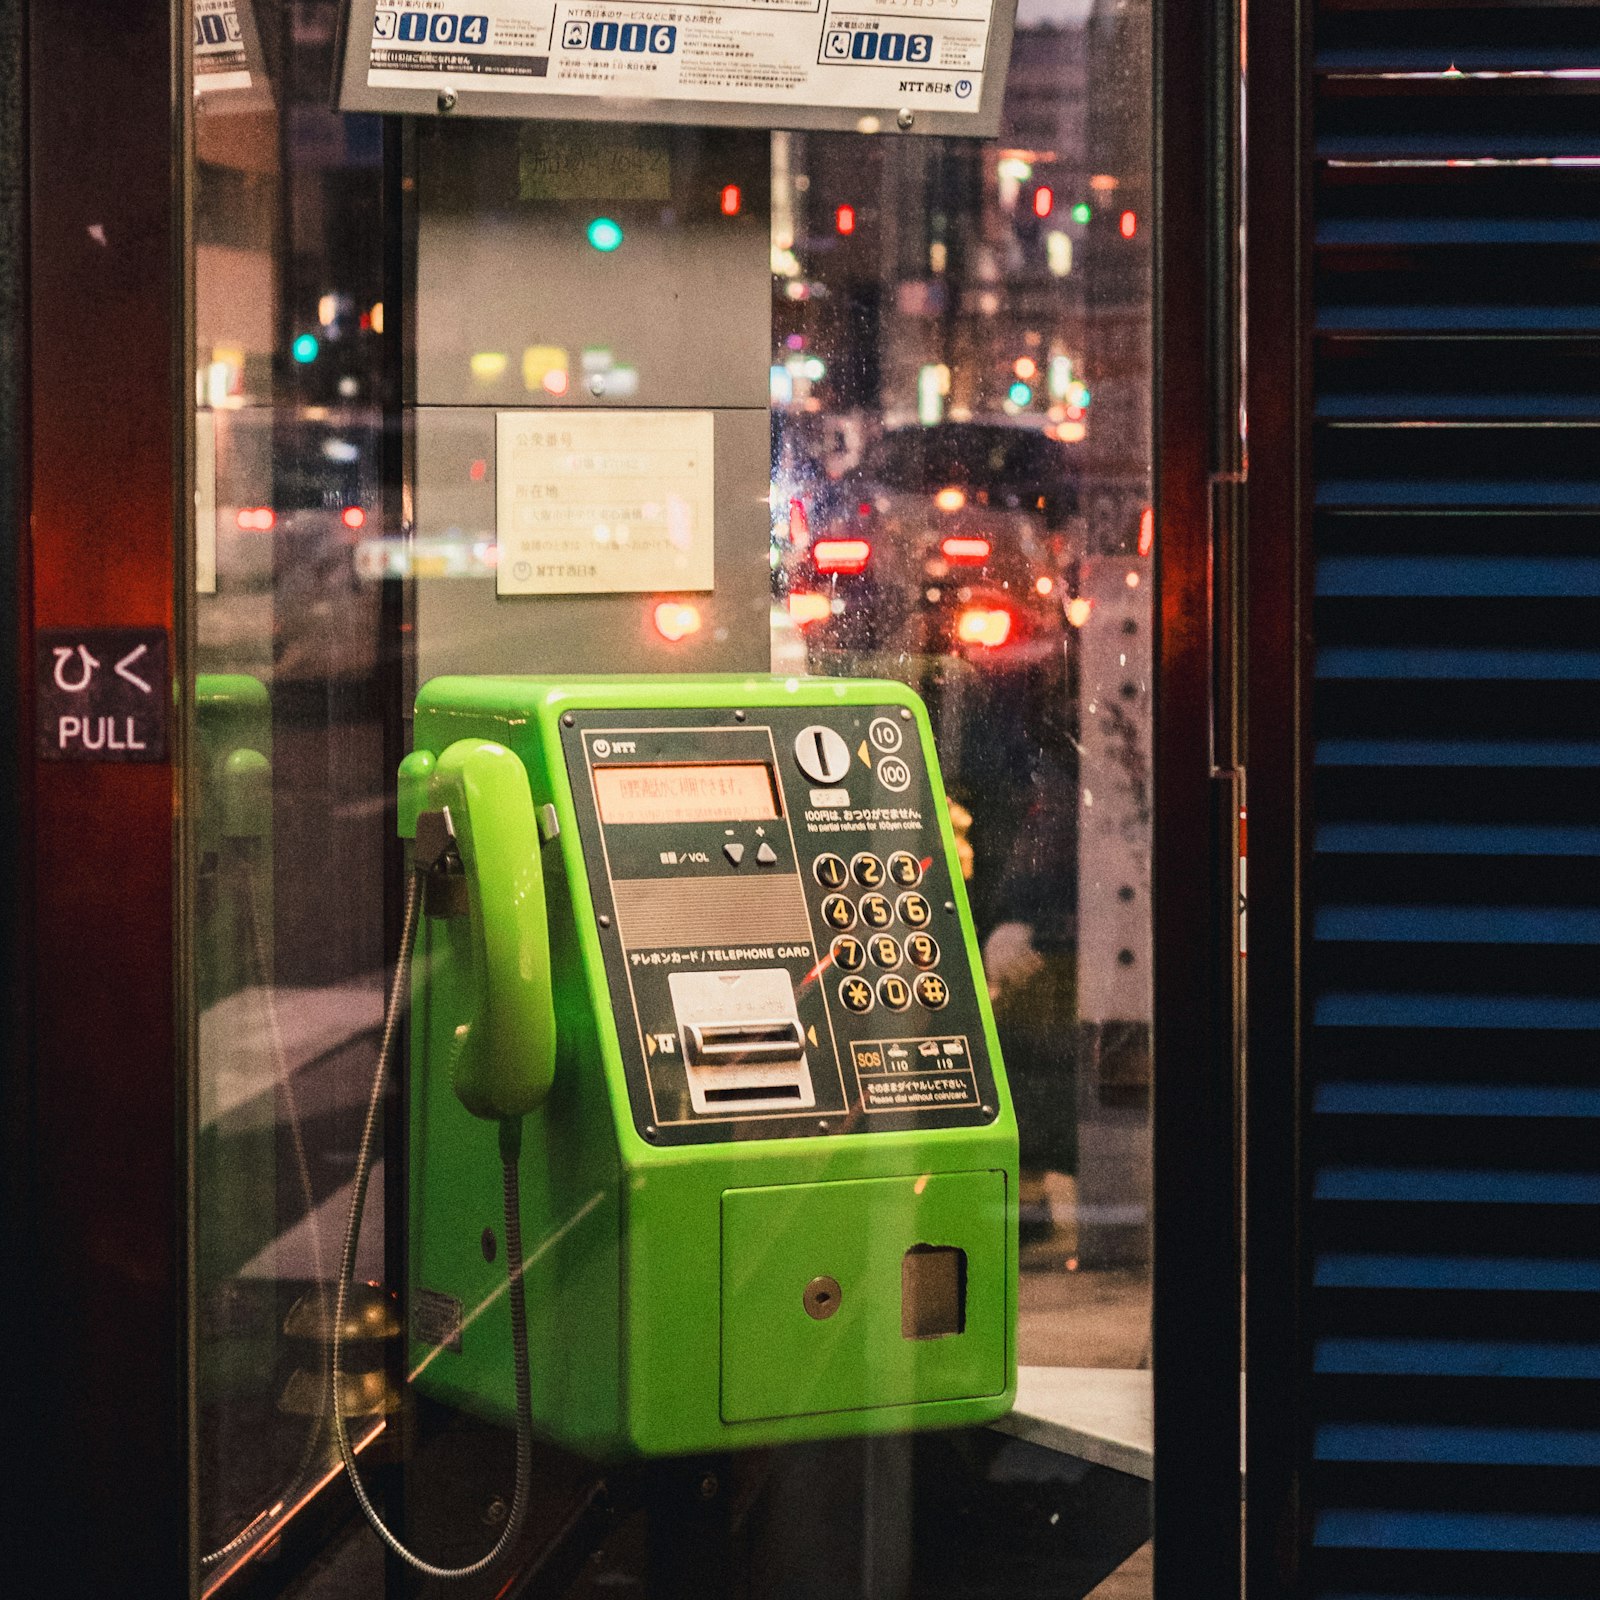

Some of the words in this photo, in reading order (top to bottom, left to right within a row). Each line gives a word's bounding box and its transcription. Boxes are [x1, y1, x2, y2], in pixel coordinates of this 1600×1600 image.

[408, 14, 484, 44] 104
[599, 23, 671, 52] 116
[829, 21, 880, 30] 公衆電話の故障
[860, 34, 928, 62] 113
[899, 82, 954, 94] NTT西日本
[536, 564, 598, 578] NTT西日本
[52, 644, 152, 693] ひく
[59, 715, 147, 750] PULL
[612, 741, 636, 754] NTT
[862, 856, 880, 883] 2
[899, 856, 915, 882] 3
[833, 899, 849, 923] 4
[870, 897, 887, 923] 5
[906, 896, 925, 922] 6
[707, 947, 776, 962] TELEPHONE
[777, 945, 810, 959] CARD
[842, 939, 857, 966] 7
[878, 939, 897, 964] 8
[915, 937, 932, 962] 9
[887, 979, 906, 1006] 0
[857, 1052, 882, 1068] SOS
[890, 1060, 909, 1072] 110
[936, 1058, 954, 1070] 119
